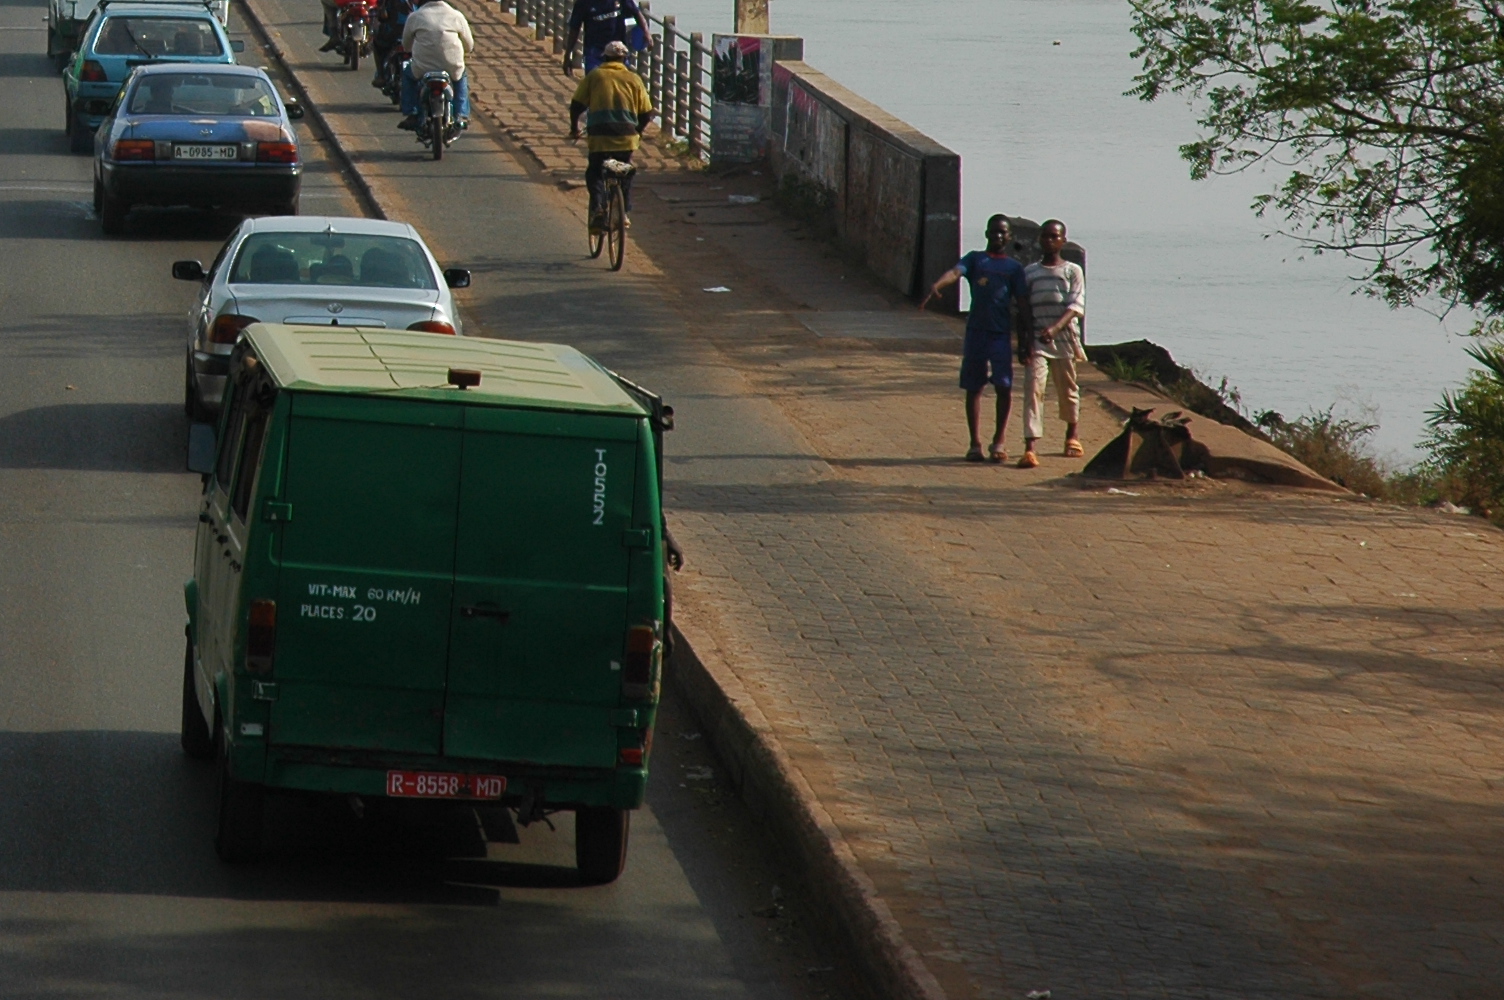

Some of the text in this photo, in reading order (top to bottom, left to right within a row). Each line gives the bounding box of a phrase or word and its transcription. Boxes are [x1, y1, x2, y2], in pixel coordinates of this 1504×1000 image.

[367, 588, 384, 600] 60
[386, 587, 421, 605] KM/H
[352, 604, 377, 622] 20
